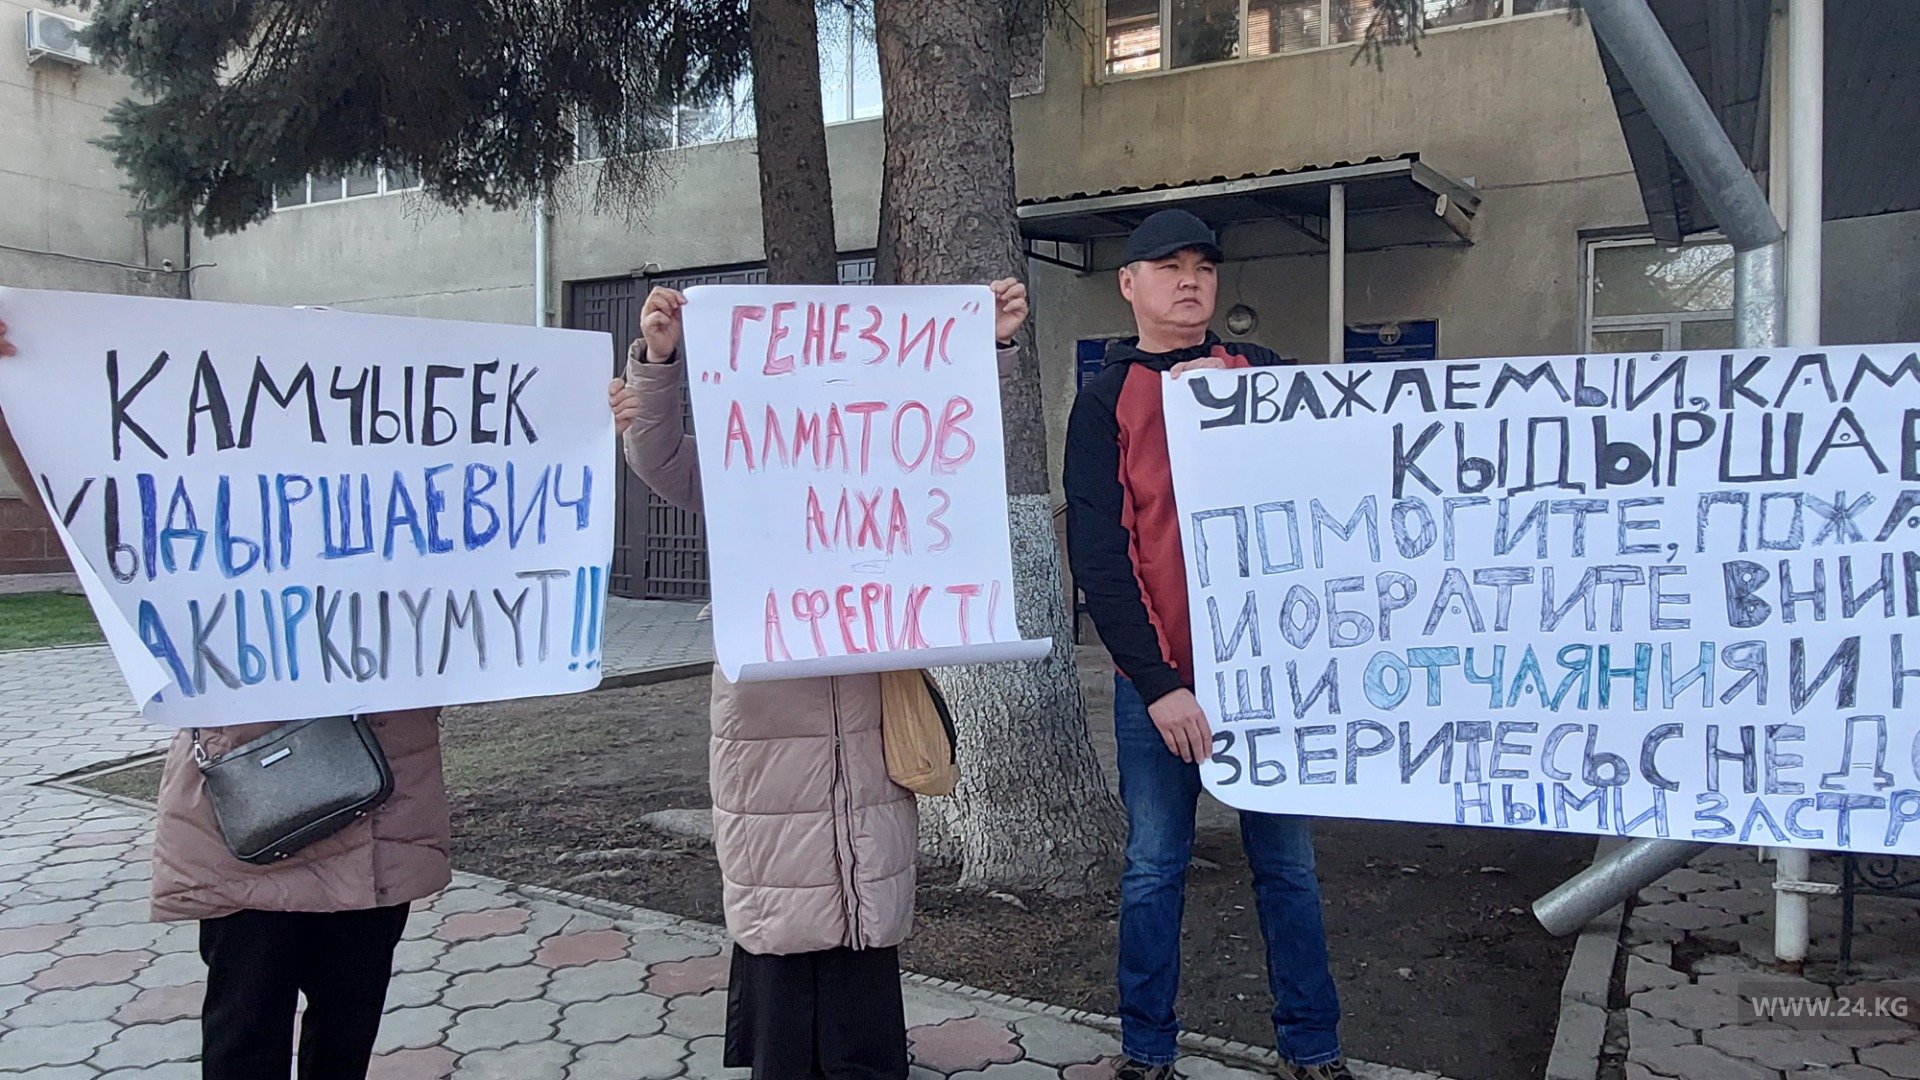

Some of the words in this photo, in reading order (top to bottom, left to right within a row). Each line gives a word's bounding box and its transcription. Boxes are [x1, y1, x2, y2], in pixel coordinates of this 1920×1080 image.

[106, 349, 540, 461] КАМЧЫБЕК
[1188, 354, 1710, 430] УВАЖАЕМЫЙ,
[724, 395, 976, 477] АЛМАТОВ
[806, 483, 953, 556] АЛХАЗ
[1191, 494, 1680, 588] ПОМОГИТЕ,
[1207, 590, 1261, 663] И
[1279, 564, 1691, 649] ОБРАТИТЕ
[1215, 657, 1341, 722] ШИ
[1363, 640, 1769, 711] ОТЧАЯНИЯ
[1789, 634, 1861, 715] И
[1453, 782, 1669, 838] НЫМИ
